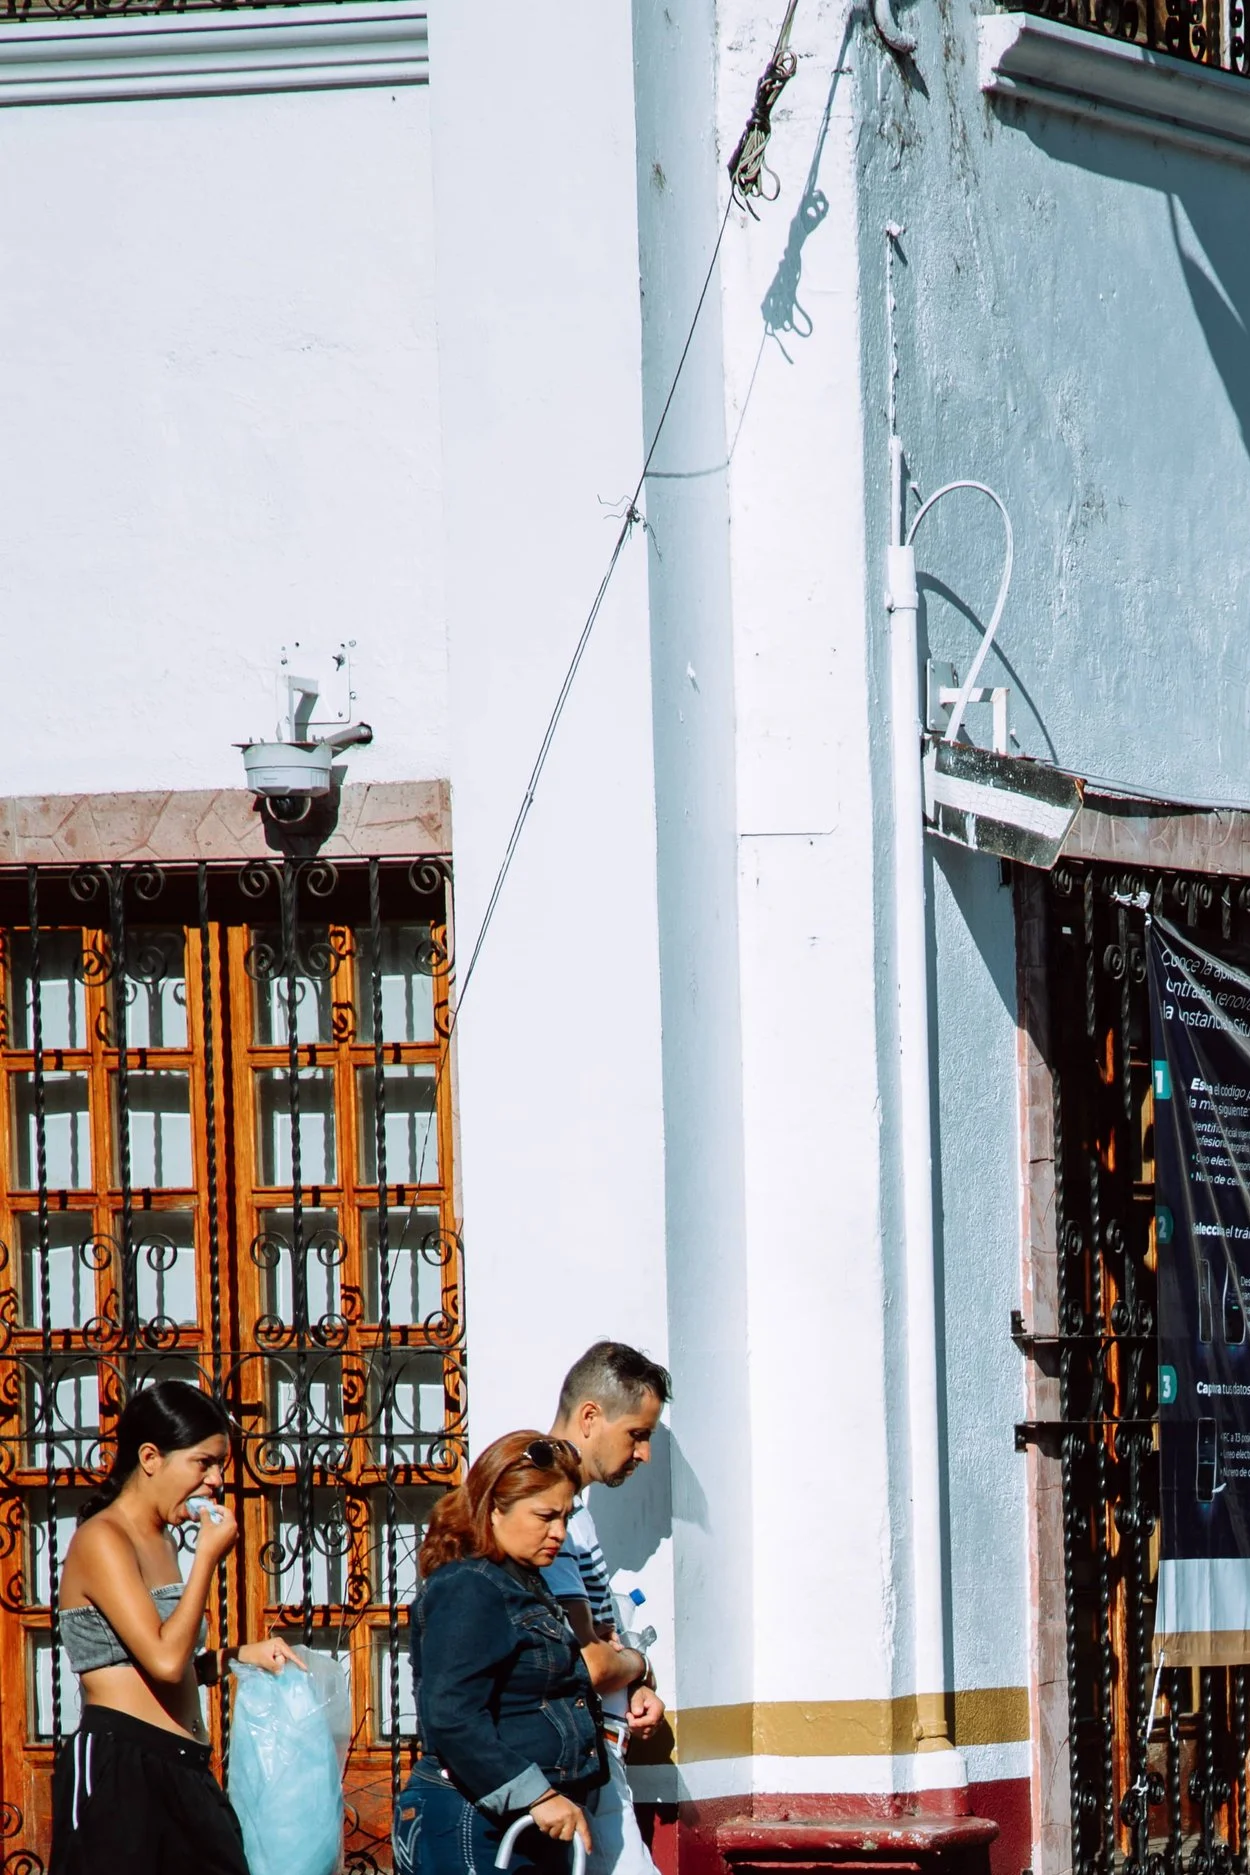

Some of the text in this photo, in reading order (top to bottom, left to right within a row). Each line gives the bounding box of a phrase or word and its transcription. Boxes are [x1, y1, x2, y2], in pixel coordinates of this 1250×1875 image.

[1163, 999, 1174, 1020] la
[1155, 1071, 1164, 1094] 1
[1220, 1083, 1246, 1101] código
[1218, 1102, 1250, 1118] siguiente:
[1214, 1174, 1226, 1185] de
[1158, 1216, 1167, 1239] 2
[1225, 1226, 1233, 1238] el
[1162, 1374, 1172, 1398] 3
[1239, 1466, 1247, 1477] de
